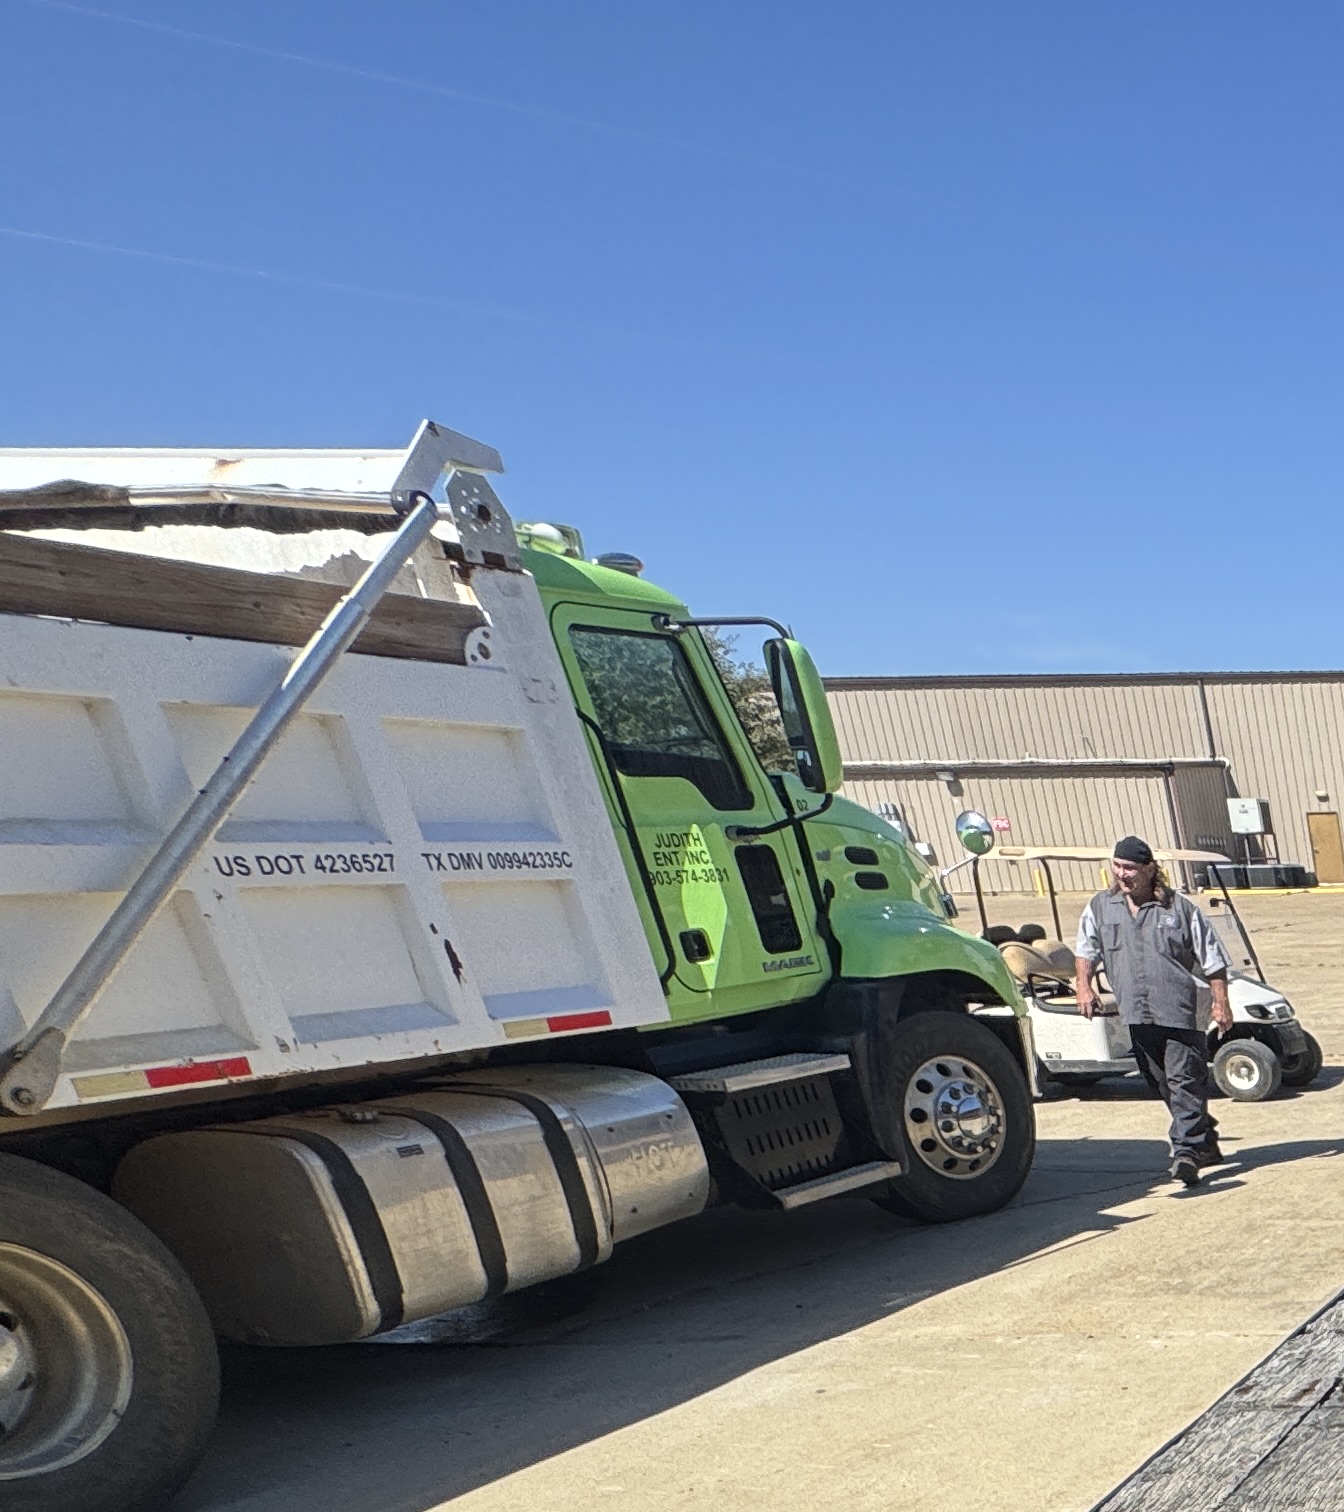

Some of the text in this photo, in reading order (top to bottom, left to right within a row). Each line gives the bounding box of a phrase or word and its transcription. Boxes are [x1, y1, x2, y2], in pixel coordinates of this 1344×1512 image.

[655, 832, 703, 848] JUDITH
[213, 853, 395, 877] US DOT 4236527
[421, 851, 573, 871] TX DMV 009942335C
